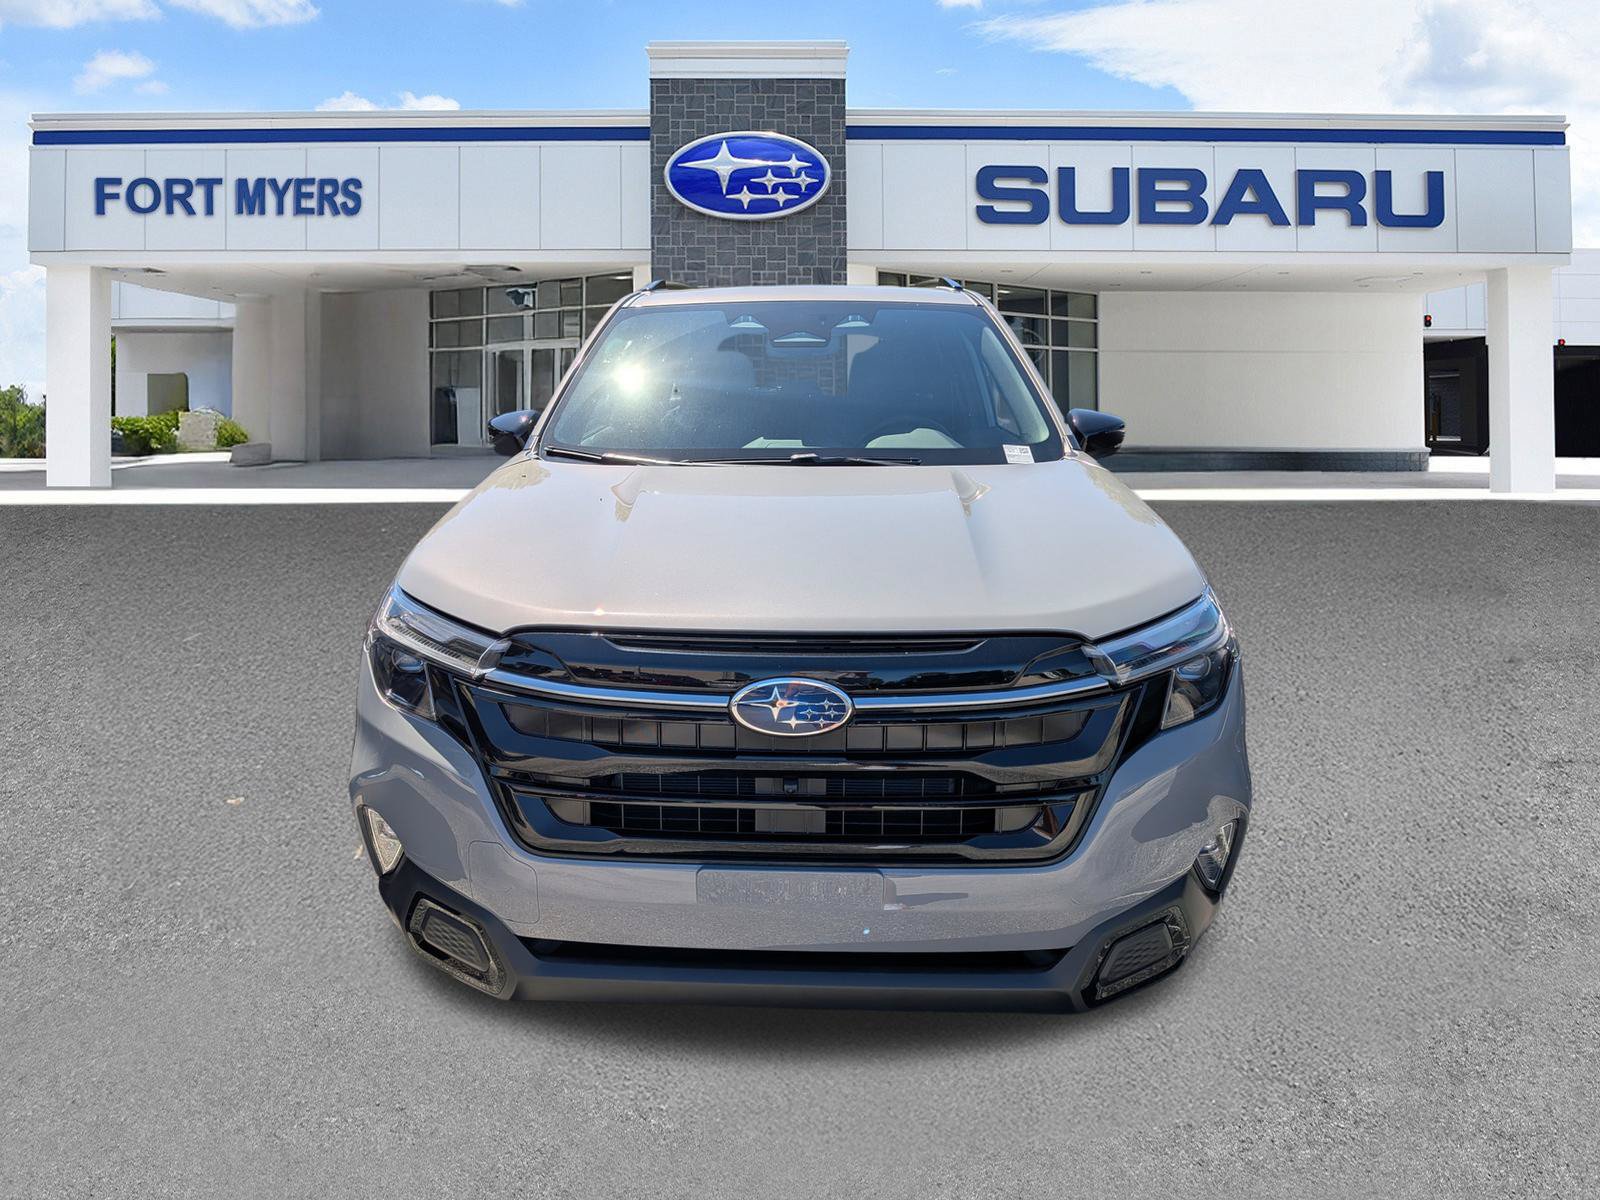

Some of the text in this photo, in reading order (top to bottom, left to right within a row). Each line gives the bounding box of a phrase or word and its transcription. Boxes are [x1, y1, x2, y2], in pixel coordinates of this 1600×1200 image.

[95, 177, 363, 216] FORT MYERS
[975, 164, 1446, 228] SUBARU
